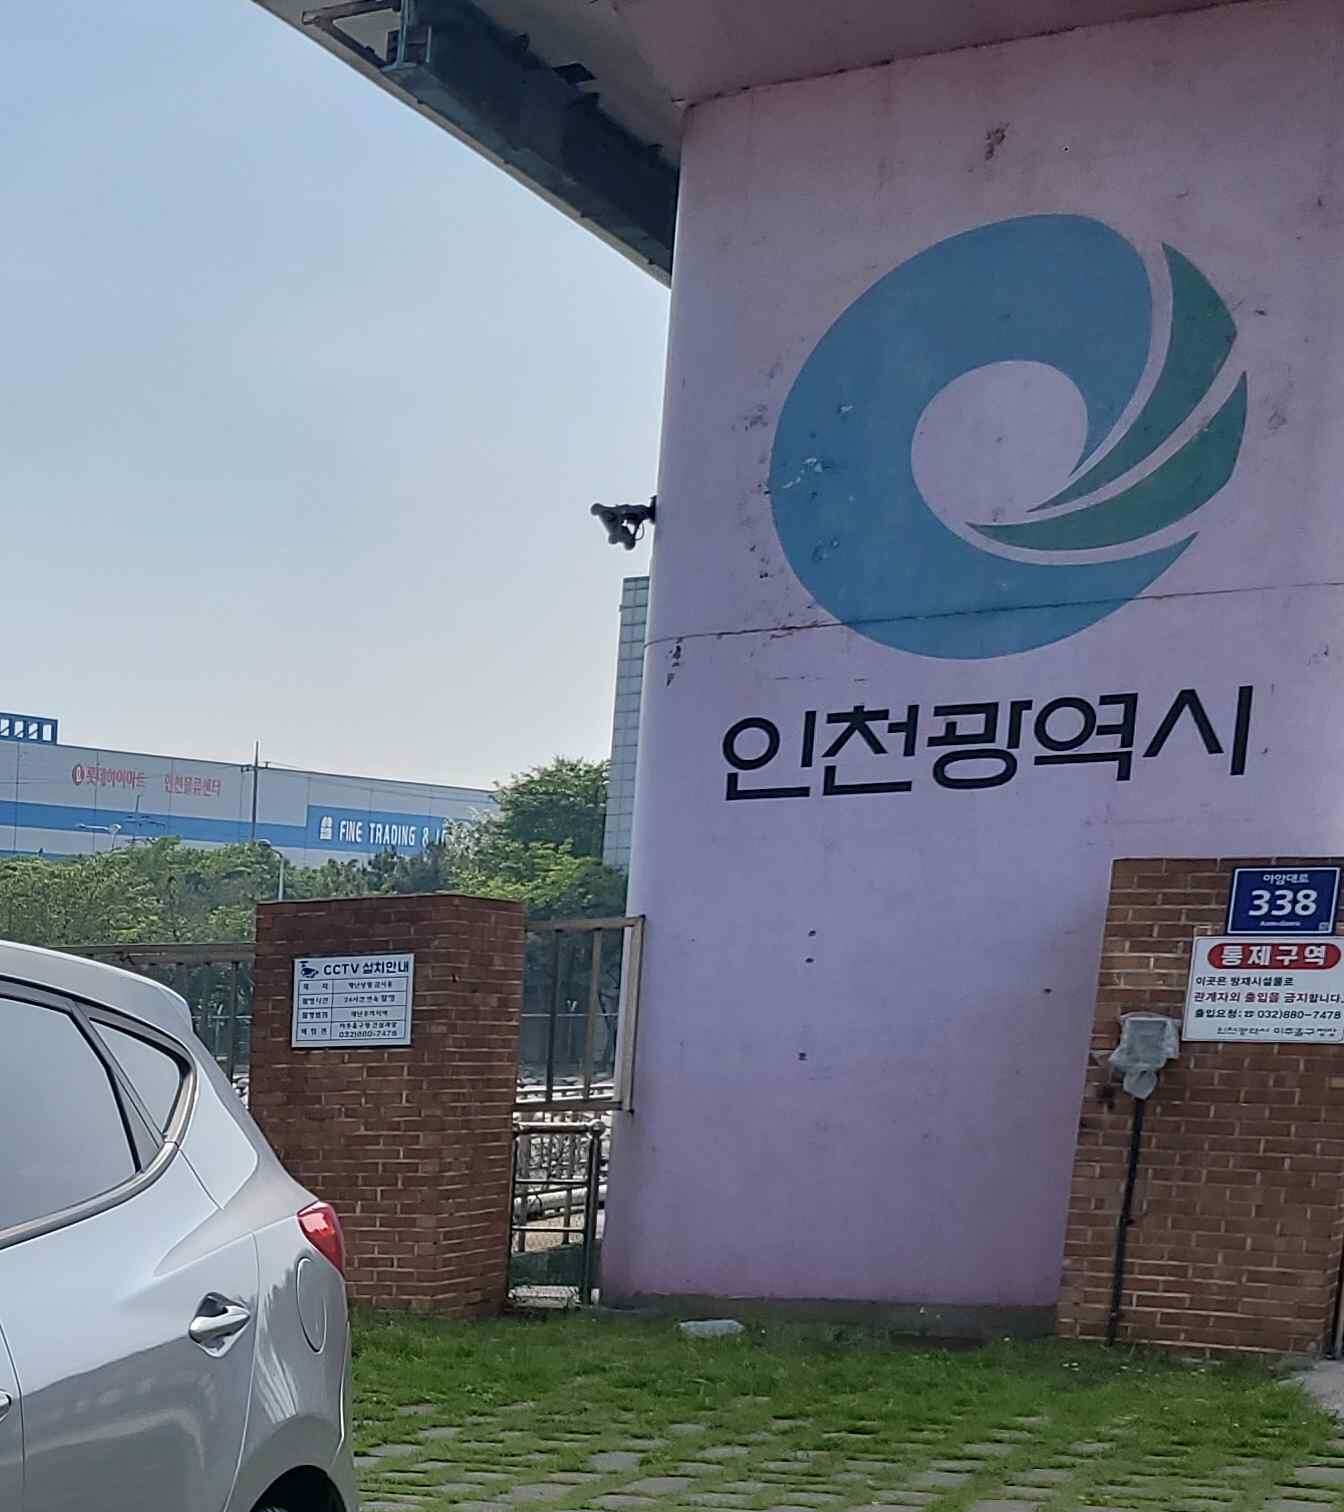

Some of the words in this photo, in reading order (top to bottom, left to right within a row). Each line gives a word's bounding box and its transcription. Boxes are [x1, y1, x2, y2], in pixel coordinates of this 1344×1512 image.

[721, 685, 1254, 801] 인천광역시
[339, 819, 363, 843] FINE
[369, 822, 416, 846] TRADING
[1263, 873, 1310, 886] 아암대로
[1248, 889, 1318, 916] 338
[1221, 945, 1328, 966] 통제구역
[323, 963, 360, 975] CCTV
[362, 960, 409, 975] 설치안내
[1195, 976, 1227, 987] 이곳은
[1257, 1009, 1342, 1020] 032)880-7478
